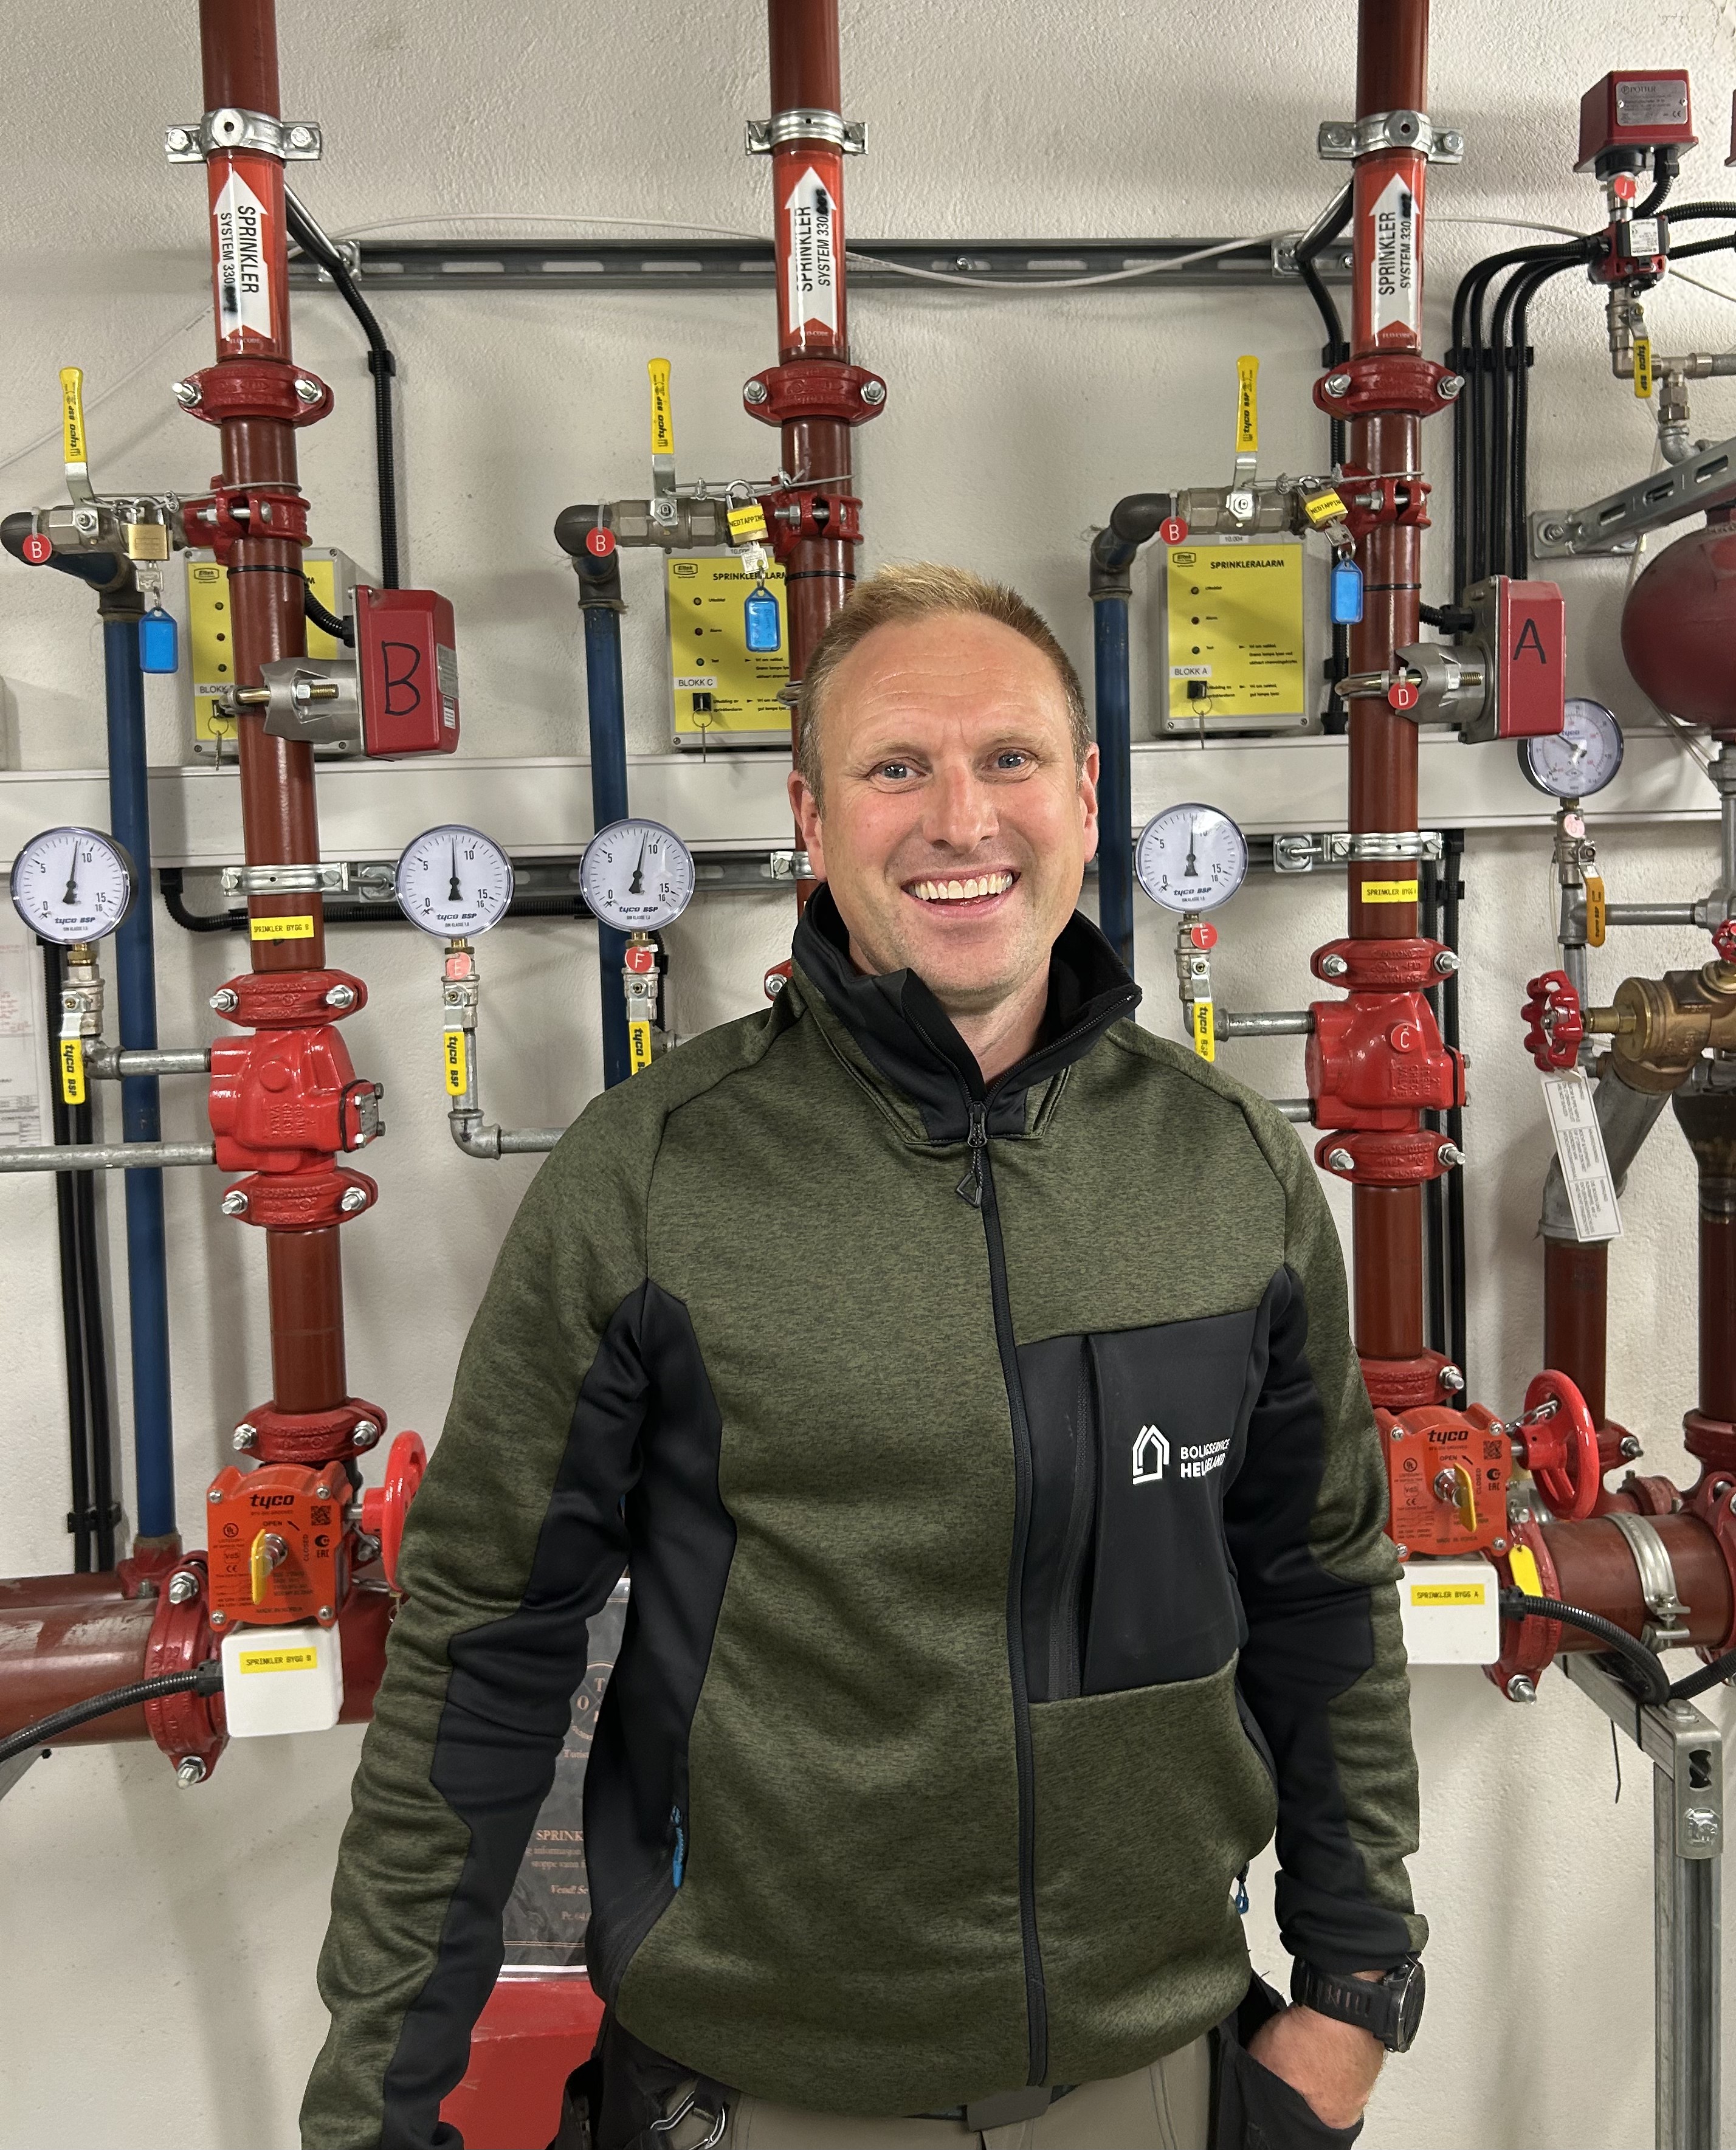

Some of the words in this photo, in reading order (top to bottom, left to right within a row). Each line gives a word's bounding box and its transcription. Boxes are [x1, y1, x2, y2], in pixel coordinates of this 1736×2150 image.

[1621, 182, 1627, 196] J
[220, 212, 235, 261] SYSTEM
[238, 205, 260, 293] SPRINKLER
[794, 206, 813, 292] SPRINKLER
[1378, 212, 1396, 296] SPRINKLER
[817, 239, 831, 287] SYSTEM
[1400, 243, 1411, 289] SYSTEM
[1637, 345, 1646, 370] tyco
[658, 415, 667, 438] tyco
[1243, 410, 1252, 433] tyco
[70, 424, 80, 448] tyco
[1309, 500, 1342, 514] NEDTAPPIN
[1169, 524, 1179, 541] B
[32, 541, 43, 559] B
[596, 535, 606, 552] B
[1210, 560, 1284, 569] SPRINKLERALARM
[1514, 618, 1547, 664] A
[381, 640, 421, 717] B
[1398, 689, 1409, 706] D
[648, 844, 658, 854] 10
[1159, 839, 1165, 849] 5
[82, 853, 92, 863] 10
[464, 850, 474, 861] 10
[607, 853, 613, 863] 5
[40, 863, 46, 873] 5
[423, 860, 429, 871] 5
[1211, 863, 1221, 873] 15
[1162, 874, 1167, 884] 0
[477, 889, 488, 899] 15
[608, 889, 613, 900] 0
[660, 883, 669, 893] 15
[96, 892, 106, 903] 15
[425, 897, 430, 908] 0
[477, 900, 484, 908] 16
[658, 894, 666, 902] 16
[43, 901, 49, 911] 0
[55, 917, 77, 926] tyco
[1199, 928, 1209, 945] F
[635, 953, 645, 968] F
[1197, 1006, 1208, 1034] tyco
[632, 1027, 644, 1056] tyco
[1400, 1031, 1410, 1049] C
[446, 1036, 458, 1064] tyco
[63, 1044, 75, 1073] tyco
[450, 1069, 459, 1087] BSP
[67, 1078, 77, 1096] BSP
[1427, 1430, 1469, 1444] tyco
[1180, 1438, 1230, 1459] BOLIGSERVICE
[1180, 1453, 1226, 1478] HELGELAND
[249, 1494, 295, 1509] tyco
[246, 1656, 284, 1666] SPRINKLER
[286, 1655, 304, 1663] BYGG
[536, 1830, 584, 1841] SPRINK
